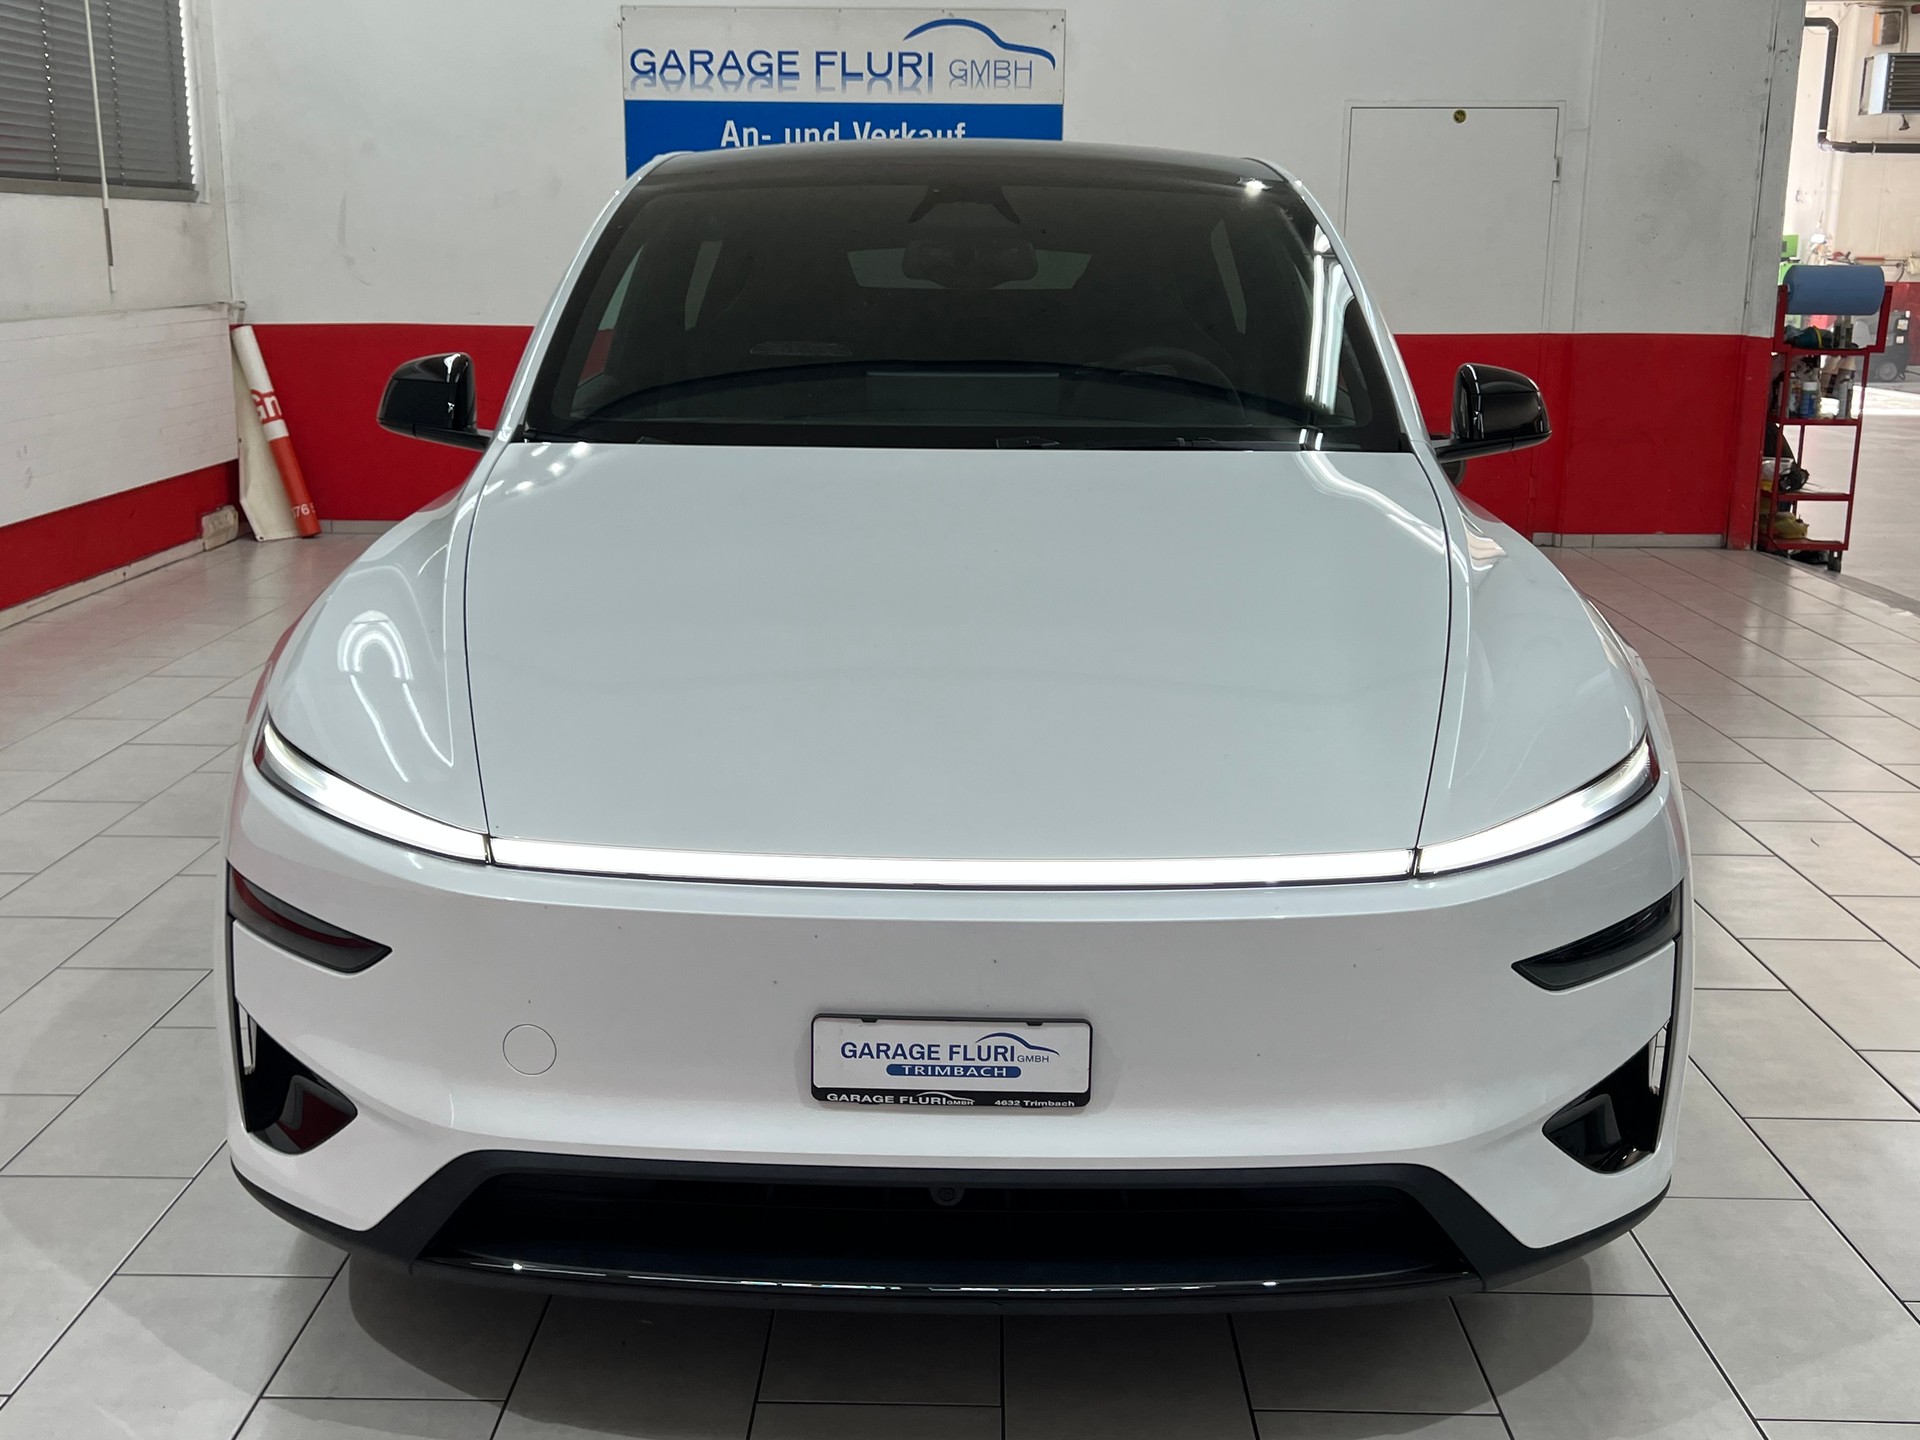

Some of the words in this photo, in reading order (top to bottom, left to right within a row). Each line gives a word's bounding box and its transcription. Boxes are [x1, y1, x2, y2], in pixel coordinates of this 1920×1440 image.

[629, 48, 800, 78] GARAGE
[815, 51, 933, 79] FLURI
[948, 59, 1033, 80] GMBH
[720, 119, 771, 148] An-
[784, 121, 840, 144] und
[840, 1042, 941, 1061] GARAGE
[948, 1044, 1015, 1062] FLURI
[1016, 1054, 1050, 1063] GMBH
[902, 1065, 1007, 1077] TRIMBACH
[826, 1093, 895, 1104] GARAGE
[900, 1096, 946, 1105] FLURI
